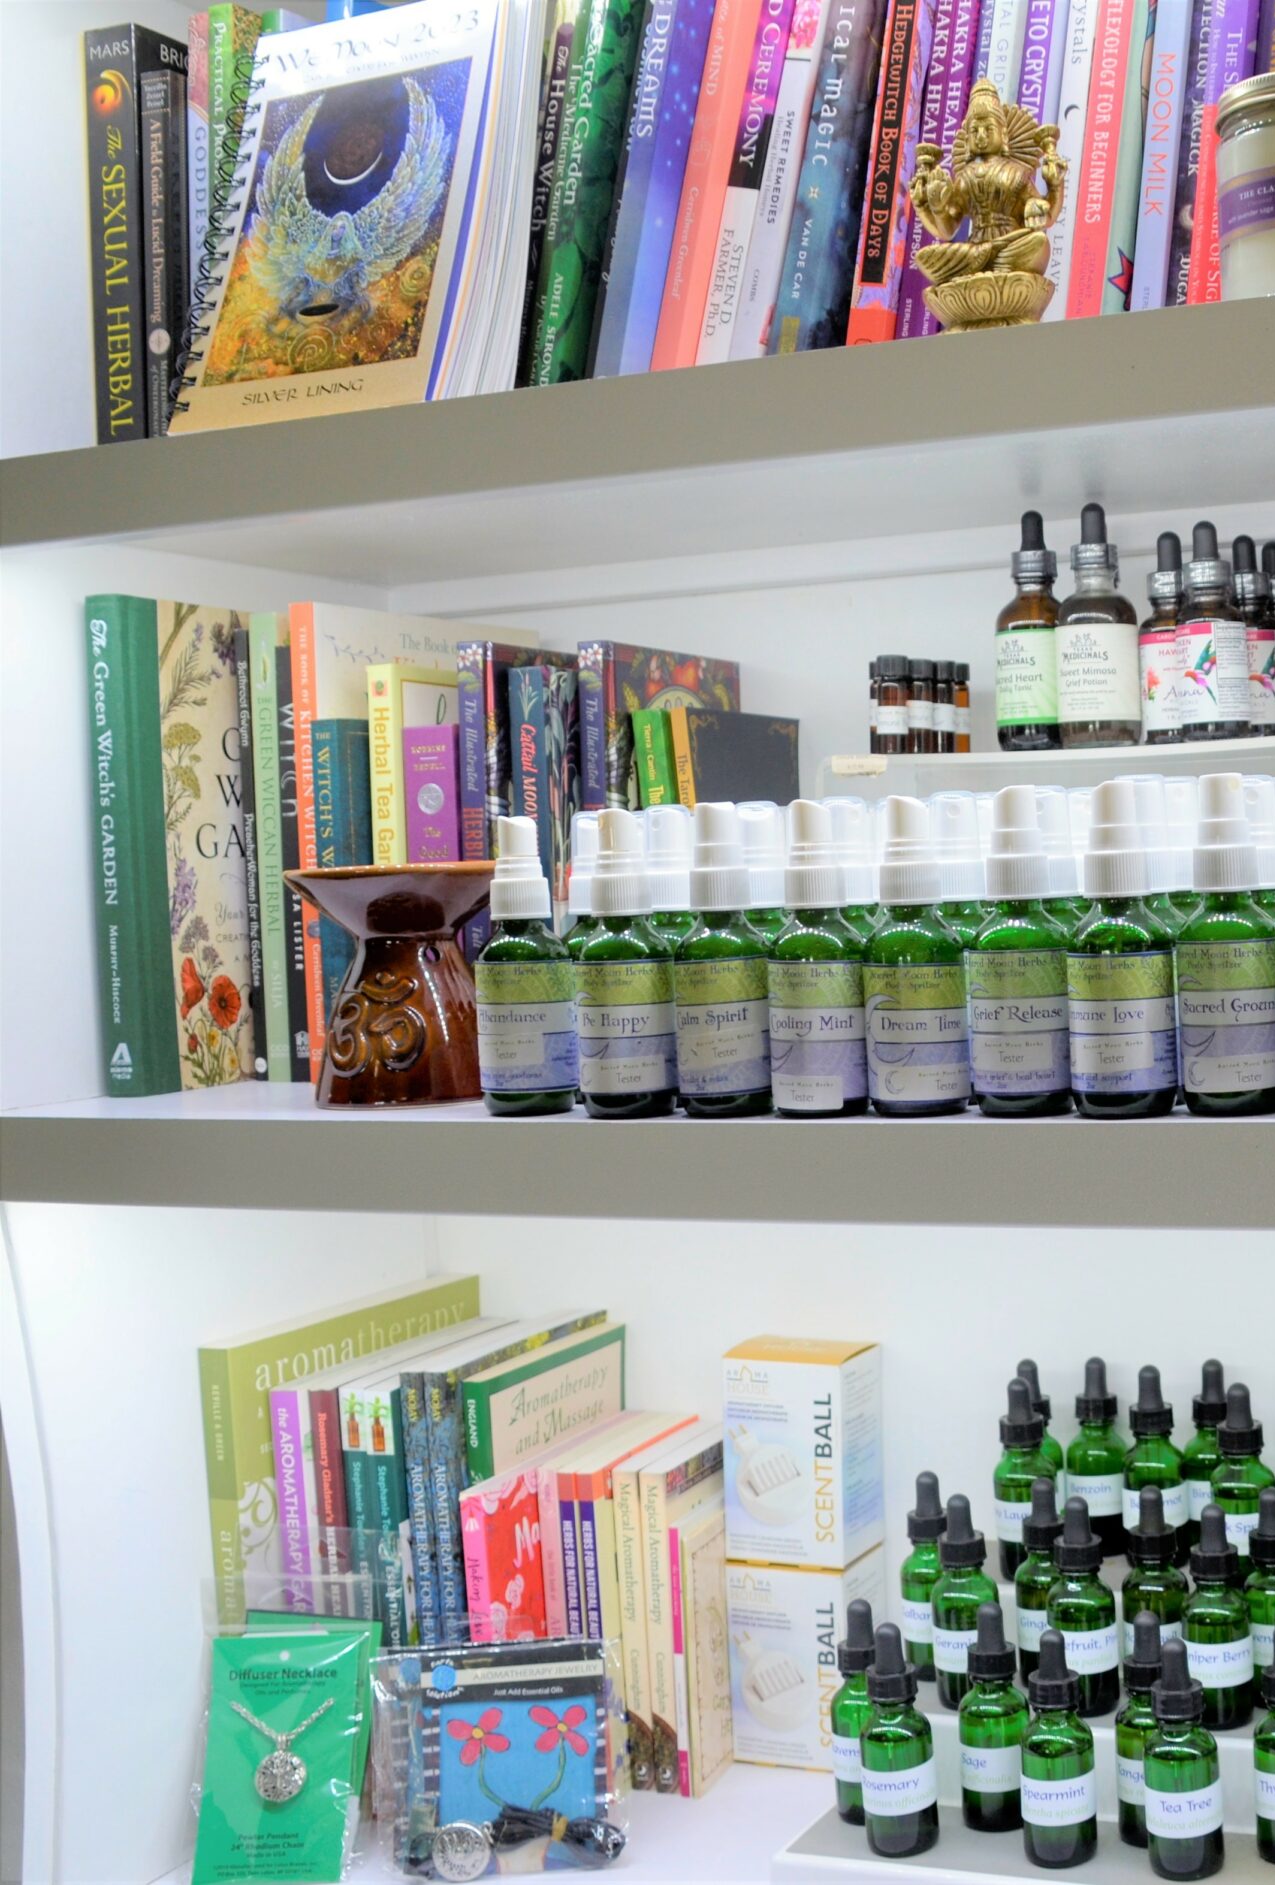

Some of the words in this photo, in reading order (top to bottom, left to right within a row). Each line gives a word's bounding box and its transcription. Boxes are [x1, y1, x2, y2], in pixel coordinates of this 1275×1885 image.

[89, 40, 130, 60] MARS
[213, 21, 228, 116] PRACTICAL
[636, 13, 672, 139] DREAMS
[706, 45, 725, 97] MIND
[543, 79, 566, 155] House
[1149, 53, 1177, 142] MOON
[106, 125, 122, 160] The
[150, 132, 164, 166] Field
[781, 110, 796, 154] SWEET
[151, 167, 164, 207] Guide
[563, 116, 590, 206] Garden
[1084, 131, 1110, 224] BEGINNERS
[1144, 151, 1171, 218] MILK
[531, 160, 555, 232] Witch
[767, 158, 787, 225] REMEDIES
[1239, 189, 1255, 201] THE
[102, 164, 129, 296] SEXUAL
[151, 217, 165, 254] Lucid
[800, 217, 814, 247] VAN
[151, 255, 165, 324] Dreaming
[724, 244, 745, 304] STEVEN
[106, 304, 134, 436] HERBAL
[242, 387, 298, 406] SILVER
[306, 378, 364, 398] LINING
[89, 619, 108, 657] The
[92, 661, 110, 727] Green
[1015, 672, 1043, 682] Heart
[464, 699, 479, 724] The
[258, 706, 273, 770] GREEN
[300, 709, 315, 798] KITCHEN
[373, 706, 391, 776] Herbal
[465, 727, 479, 792] Illustrated
[518, 724, 538, 775] Cattail
[586, 724, 600, 789] Illustrated
[96, 730, 116, 807] Witch's
[316, 747, 334, 838] WITCH'S
[262, 772, 279, 858] WICCAN
[376, 782, 395, 820] Tea
[100, 815, 119, 905] GARDEN
[243, 812, 256, 901] PreacherWoman
[250, 938, 261, 987] Goddess
[264, 864, 281, 936] HERBAL
[293, 920, 304, 971] LISTER
[600, 1012, 651, 1034] Happy
[704, 1007, 749, 1031] Spirit
[770, 1014, 813, 1038] Cooling
[819, 1014, 855, 1031] Mint
[880, 1016, 928, 1032] Dream
[973, 1005, 1003, 1024] Grief
[1007, 1005, 1064, 1024] Release
[1112, 1006, 1145, 1025] Love
[1182, 998, 1226, 1015] Sacred
[616, 1072, 643, 1084] Tester
[1097, 1051, 1126, 1065] Tester
[255, 1301, 466, 1391] aromatherapy
[277, 1407, 287, 1430] the
[508, 1365, 610, 1427] Aromatherapy
[317, 1412, 329, 1467] Rosemary
[466, 1399, 479, 1448] ENGLAND
[515, 1426, 540, 1456] and
[542, 1399, 605, 1445] Massage
[279, 1431, 304, 1574] AROMATHERAPY
[409, 1463, 432, 1573] AROMATHERAPY
[434, 1463, 457, 1575] AROMATHERAPY
[619, 1482, 633, 1534] Magical
[646, 1484, 661, 1536] Magical
[565, 1567, 580, 1612] NATURAL
[584, 1567, 598, 1612] NATURAL
[622, 1535, 639, 1624] Aromatherapy
[648, 1537, 666, 1626] Aromatherapy
[229, 1668, 279, 1681] Diffuser
[282, 1667, 338, 1680] Necklace
[472, 1668, 554, 1682] AROMATHERAPY
[554, 1662, 599, 1676] JEWELRY
[1222, 1647, 1251, 1666] Berry
[522, 1686, 550, 1696] Essential
[861, 1775, 921, 1793] Rosemary
[960, 1752, 987, 1769] Sage
[1022, 1783, 1086, 1802] Spearmint
[1159, 1799, 1183, 1813] Tea
[1186, 1797, 1213, 1812] Tree
